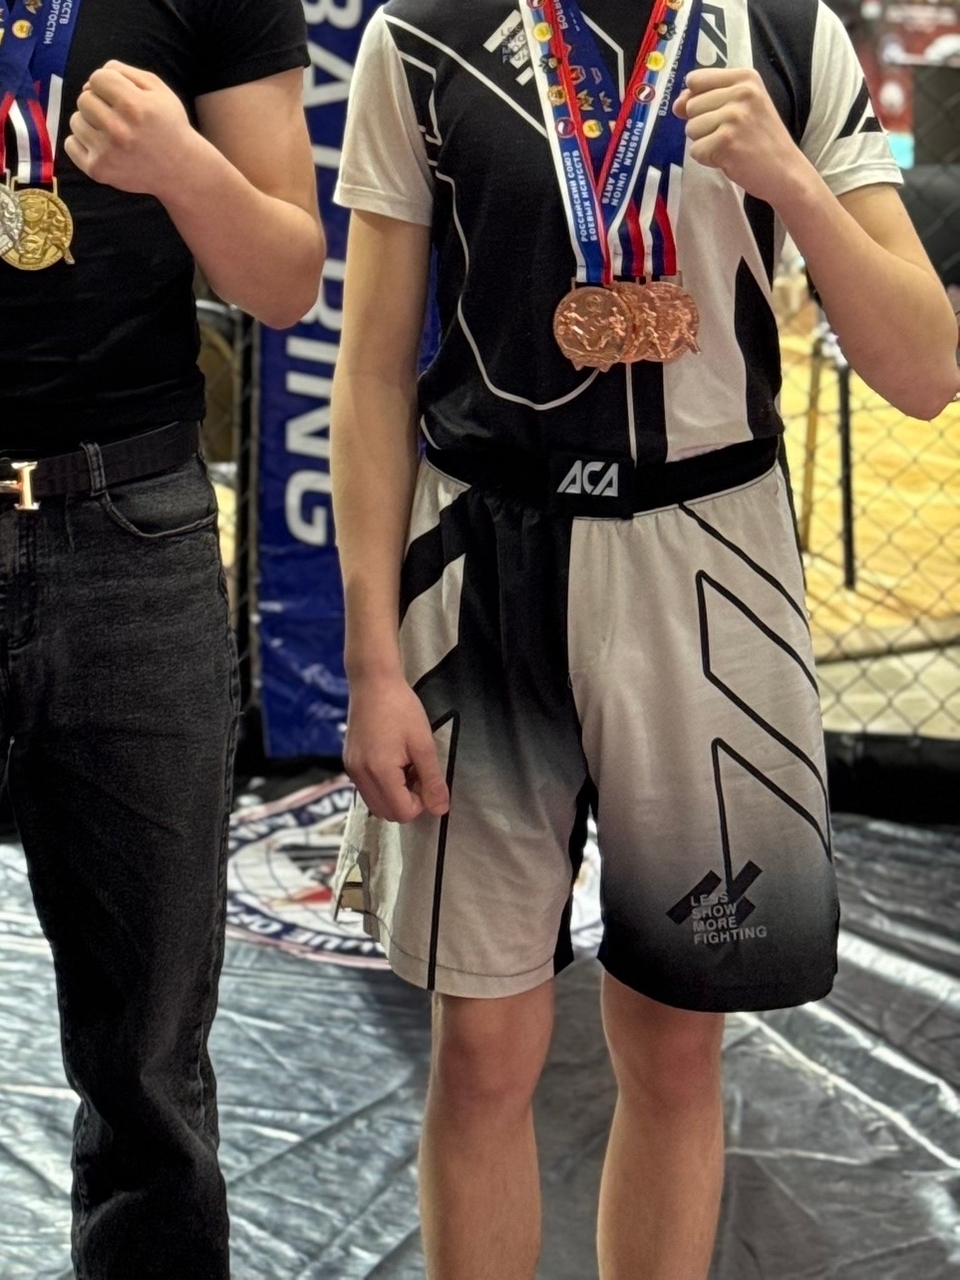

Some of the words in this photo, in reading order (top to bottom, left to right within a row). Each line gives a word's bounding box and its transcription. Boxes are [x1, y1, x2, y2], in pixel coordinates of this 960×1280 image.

[609, 131, 630, 175] MARTIAL
[623, 120, 644, 167] RUSSIAN
[562, 151, 574, 177] СОЮЗ
[572, 149, 590, 199] ИСКУССТВ
[601, 176, 617, 204] ARTS
[610, 172, 628, 207] UNION
[583, 200, 598, 242] БОЕВЫХ
[556, 459, 619, 498] ACA
[691, 892, 729, 906] LESS
[691, 902, 738, 920] SHOW
[692, 915, 738, 933] MORE
[693, 925, 768, 945] FIGHTING
